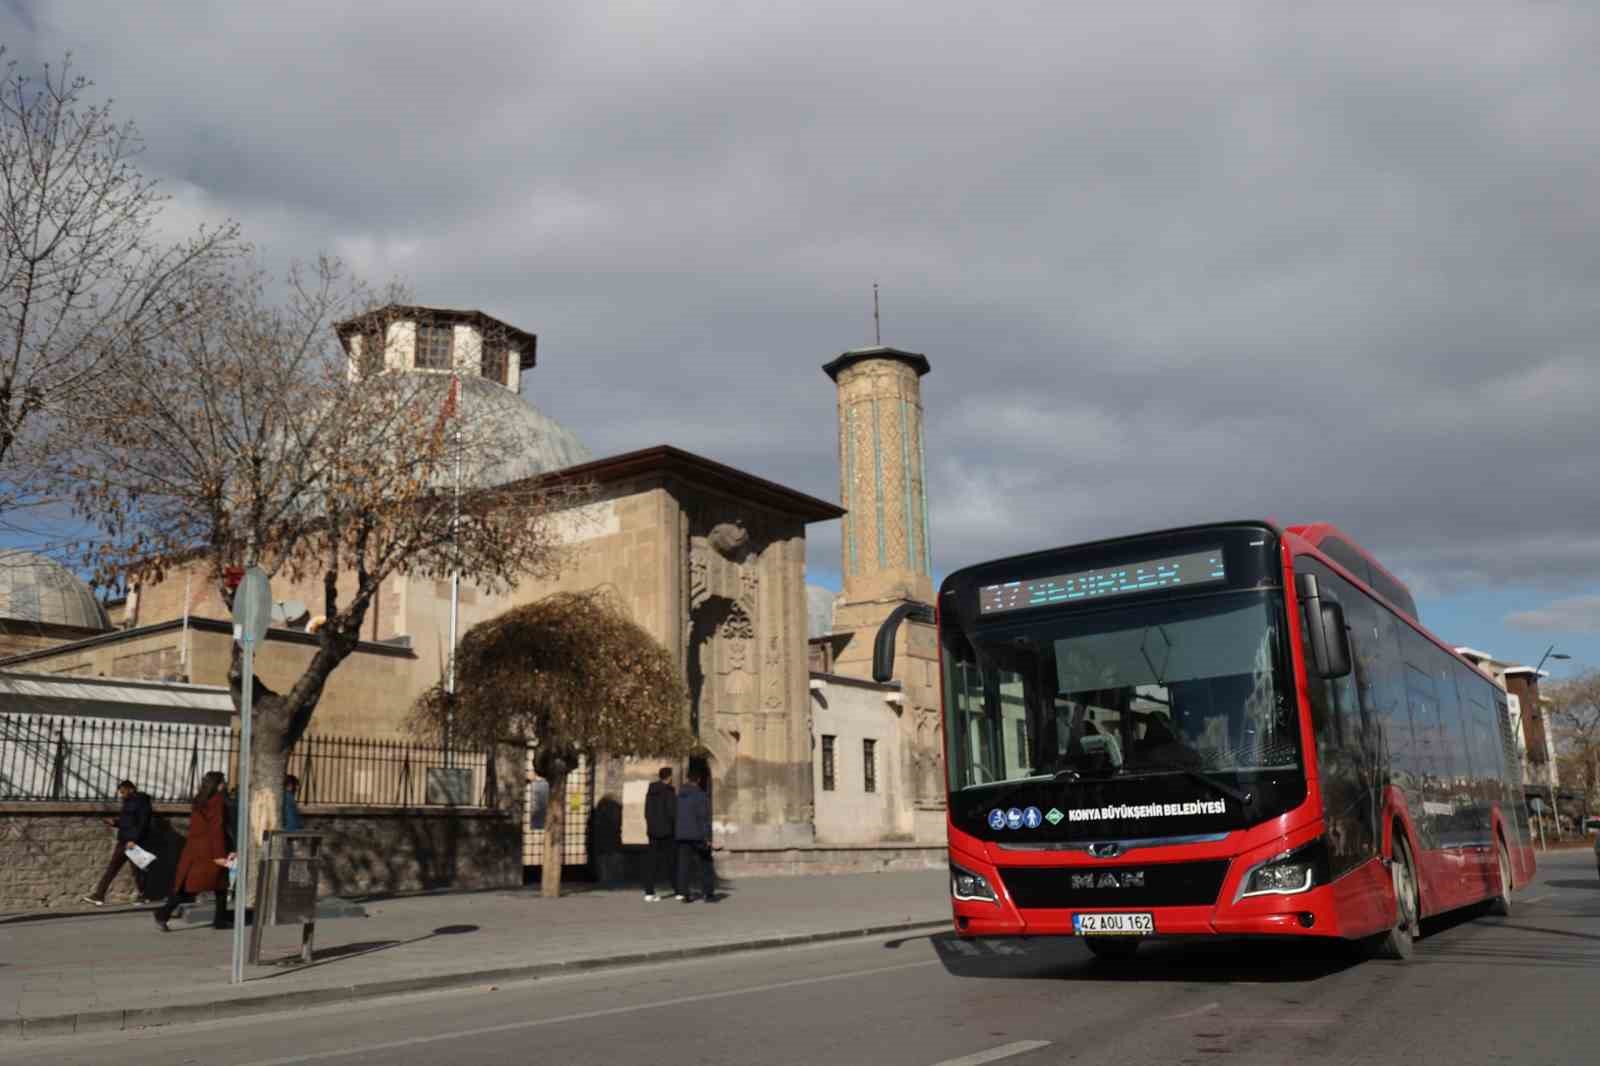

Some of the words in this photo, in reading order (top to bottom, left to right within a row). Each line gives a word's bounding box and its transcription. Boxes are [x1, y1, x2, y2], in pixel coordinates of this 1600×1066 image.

[1068, 808, 1101, 822] KONYA
[1101, 802, 1163, 820] BÜYÜKŞEHİR
[1164, 798, 1226, 816] BELEDİYESİ
[1071, 871, 1145, 889] MAN
[1081, 916, 1096, 930] 42
[1128, 915, 1152, 930] 162
